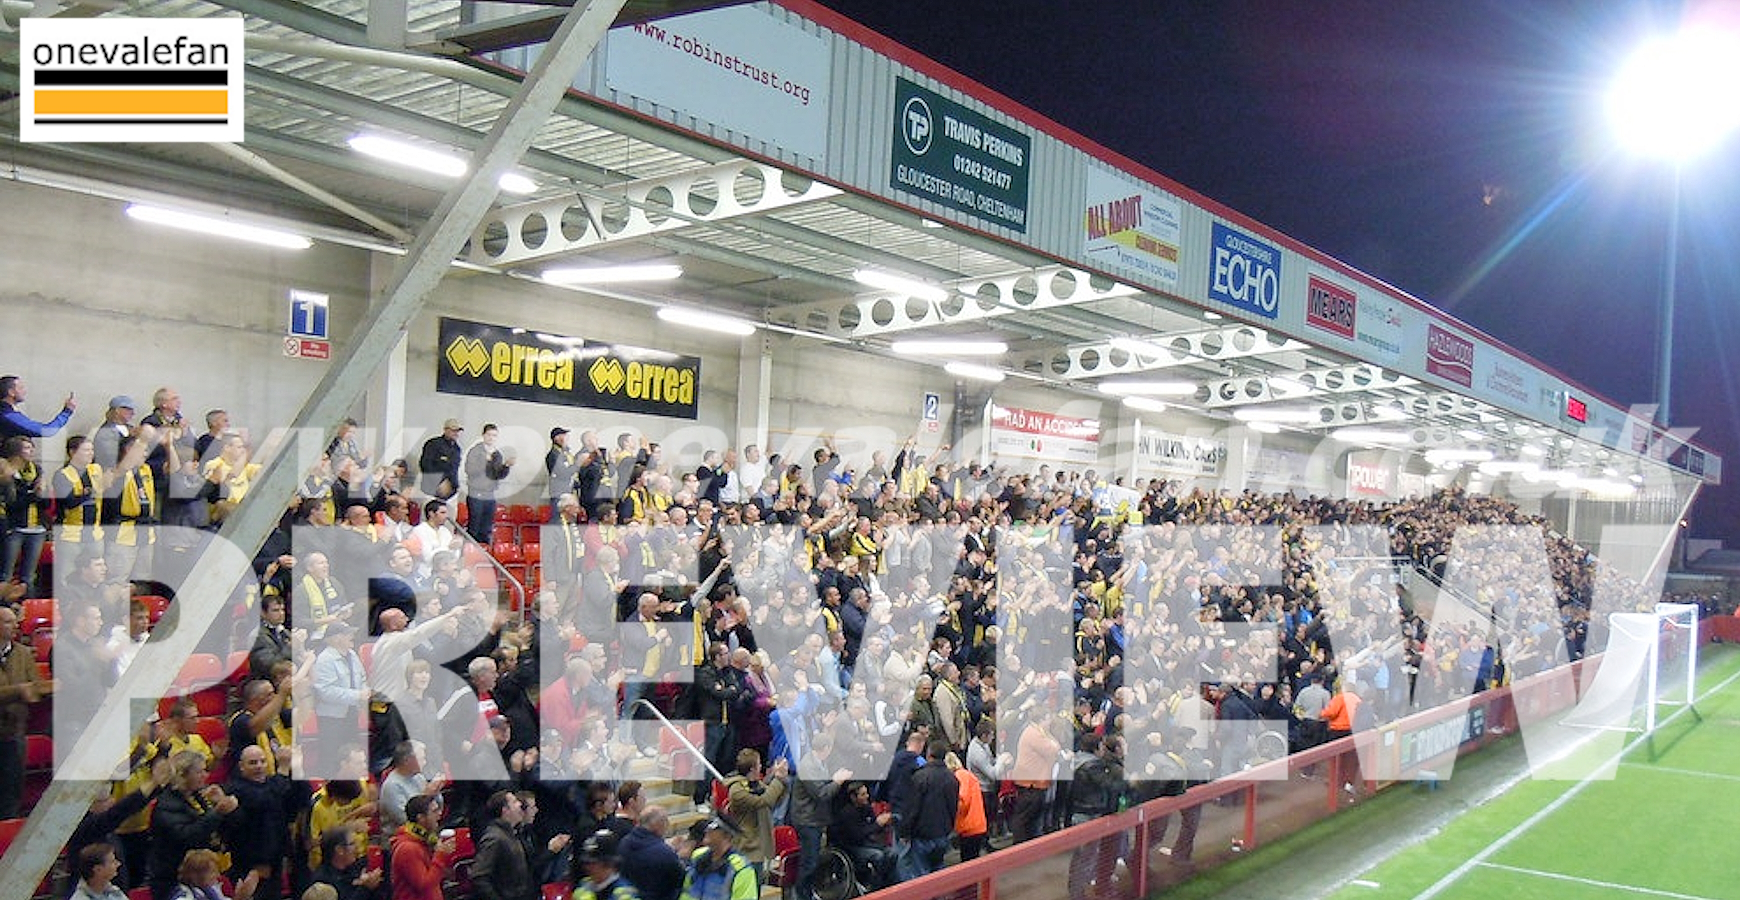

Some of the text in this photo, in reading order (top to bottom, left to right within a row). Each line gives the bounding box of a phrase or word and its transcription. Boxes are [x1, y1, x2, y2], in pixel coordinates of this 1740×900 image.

[943, 115, 1024, 167] TRAVIS PERKINS
[897, 163, 952, 199] GLOUCESTER
[953, 153, 983, 180] 01242
[1087, 194, 1142, 241] ALL ABOUT
[1212, 246, 1278, 313] ECHO
[300, 299, 314, 334] 1
[1310, 286, 1354, 329] MEARS
[925, 396, 938, 421] 2
